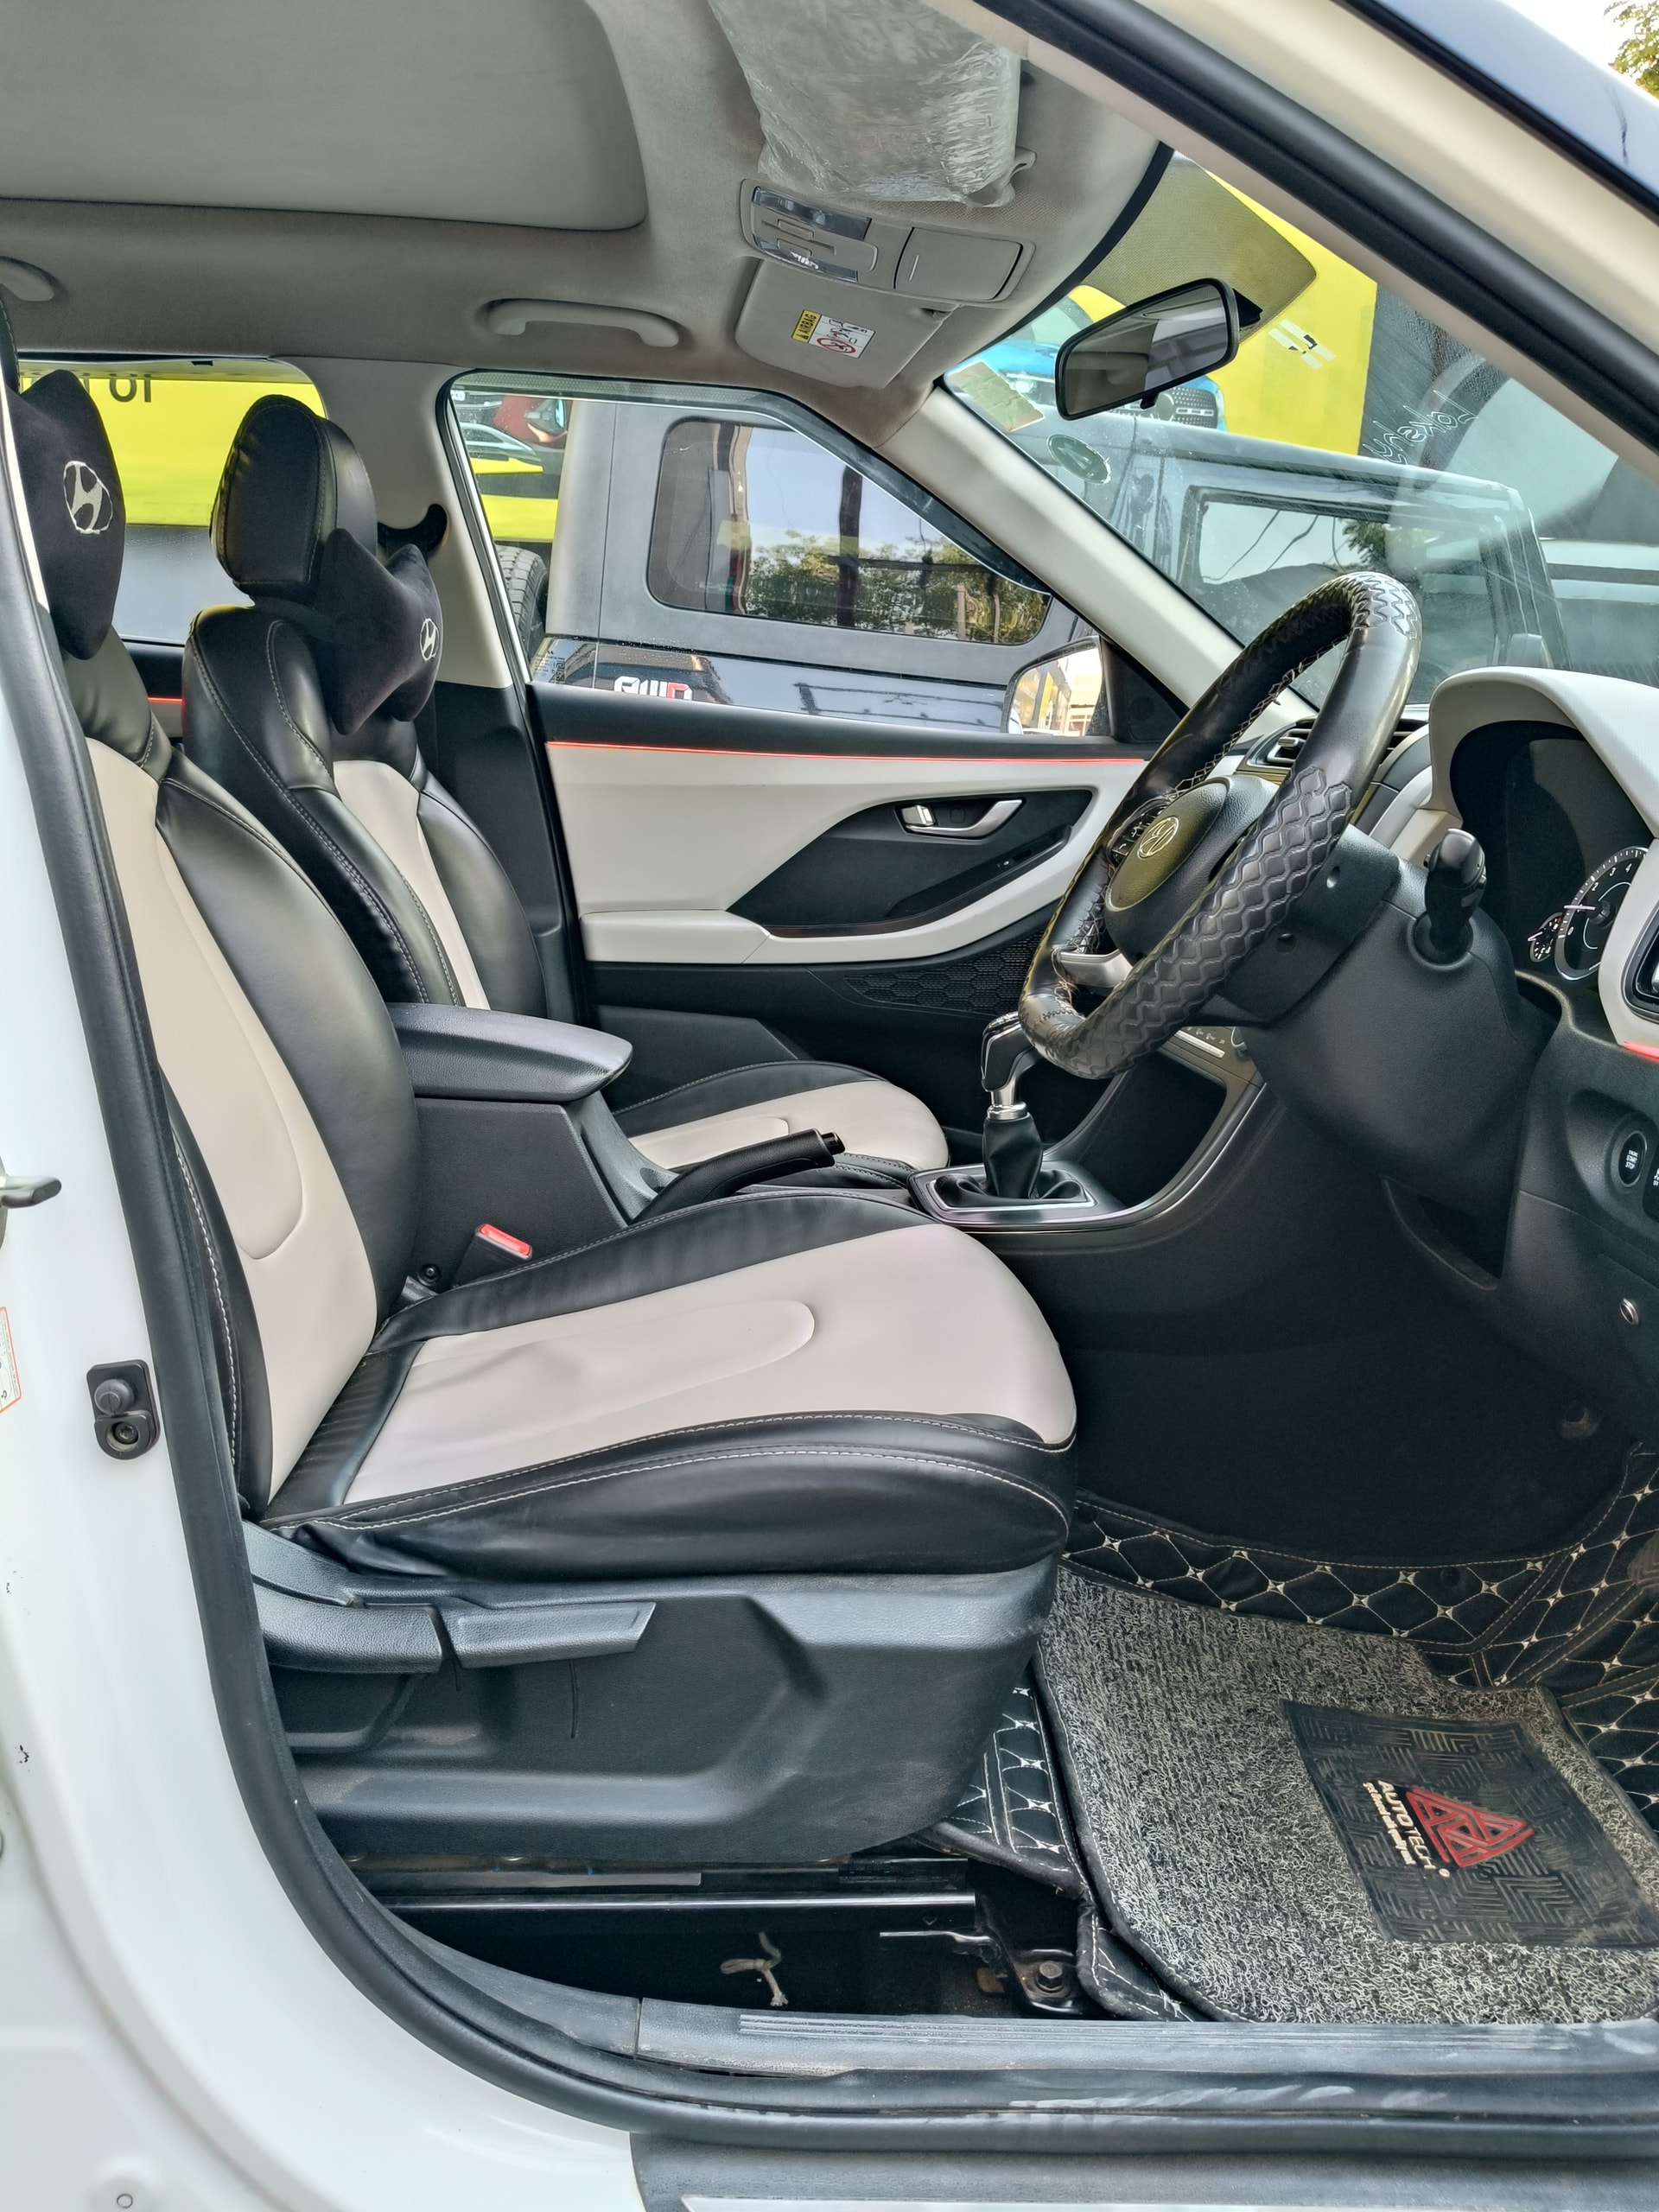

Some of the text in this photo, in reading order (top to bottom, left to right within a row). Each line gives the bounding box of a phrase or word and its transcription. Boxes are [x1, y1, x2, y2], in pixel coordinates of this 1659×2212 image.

[797, 313, 817, 335] AIRBAG
[1609, 867, 1617, 877] 3
[1625, 863, 1632, 873] 4
[1591, 881, 1599, 892] 2
[1567, 926, 1574, 936] 0
